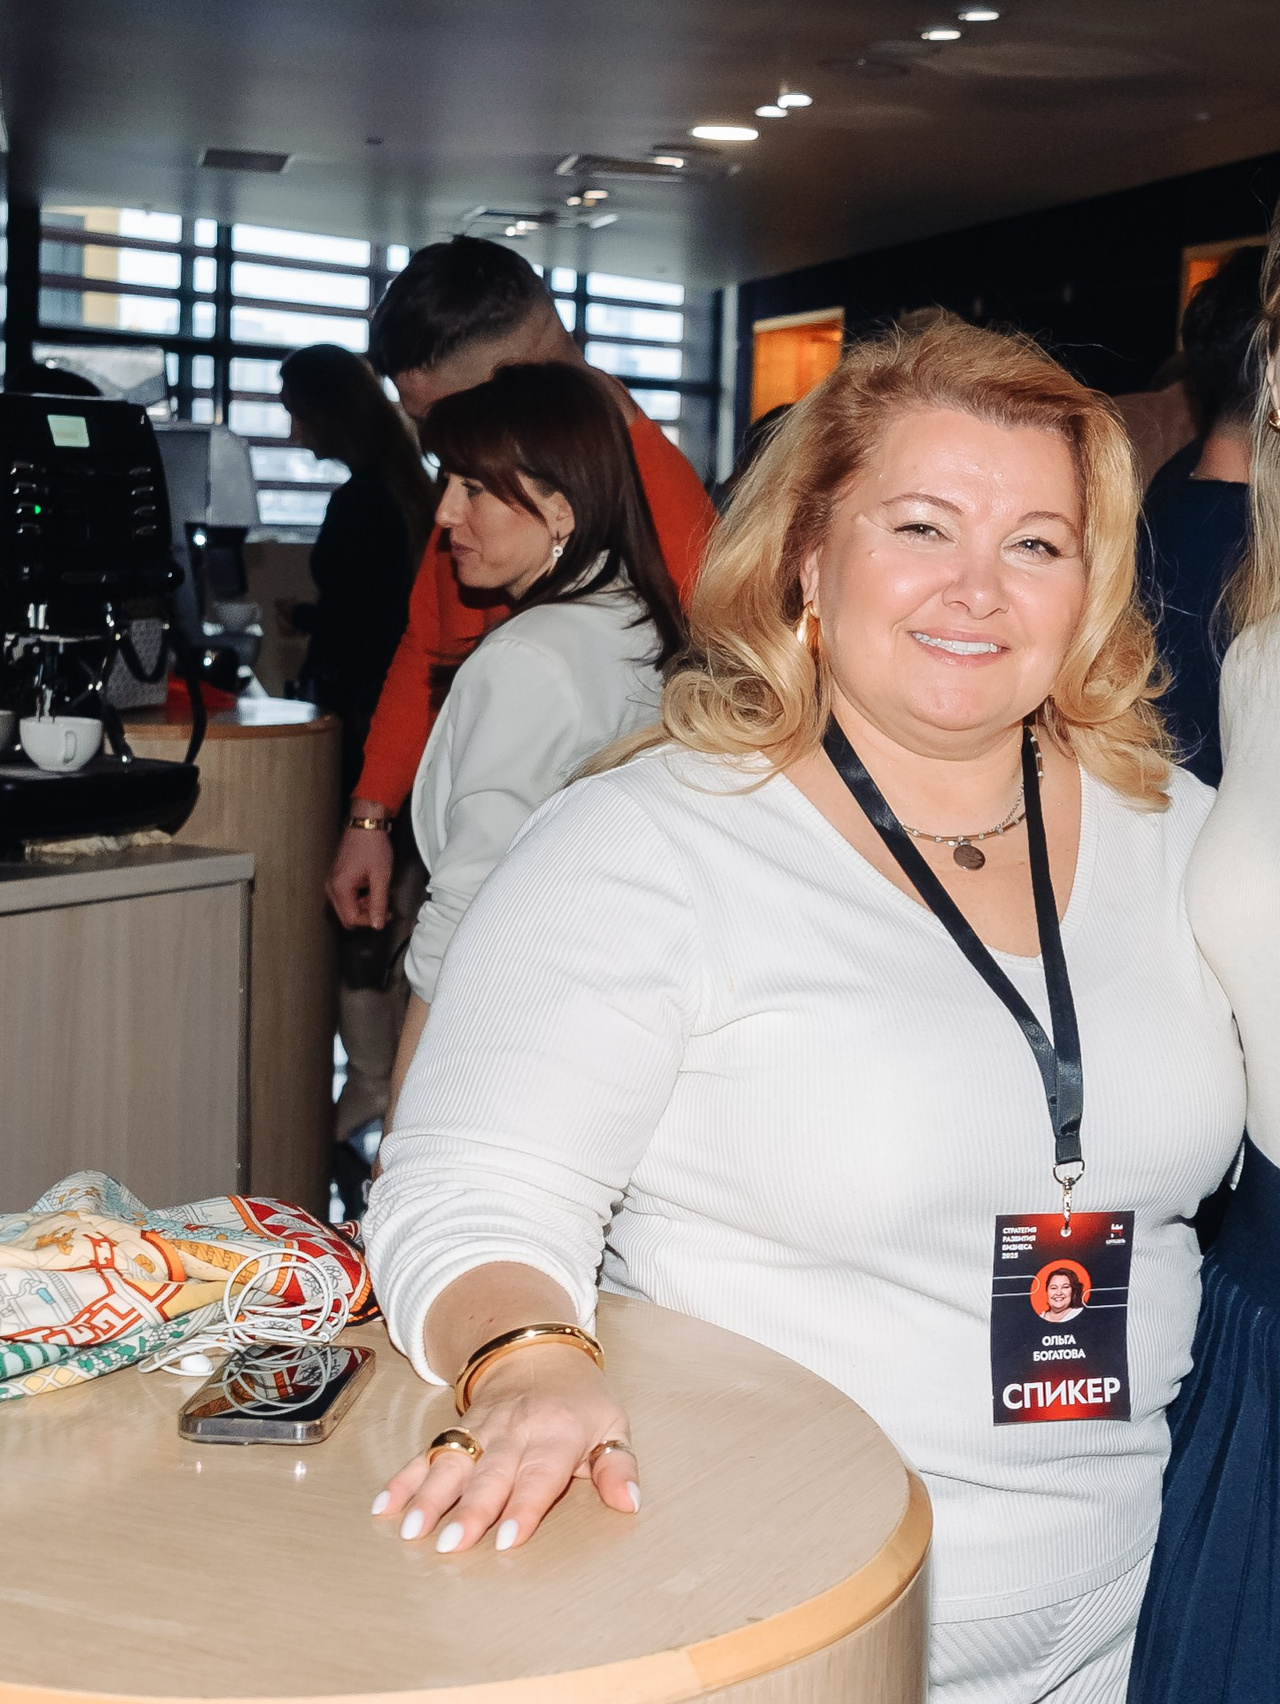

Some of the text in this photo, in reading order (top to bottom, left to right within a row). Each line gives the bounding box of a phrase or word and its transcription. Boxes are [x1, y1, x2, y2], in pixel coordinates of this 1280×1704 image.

[1002, 1243, 1033, 1251] БИЗНЕСА
[1042, 1333, 1077, 1346] ОЛЬГА
[1033, 1348, 1086, 1362] БОГАТОВА
[1002, 1377, 1121, 1410] СПИКЕР
